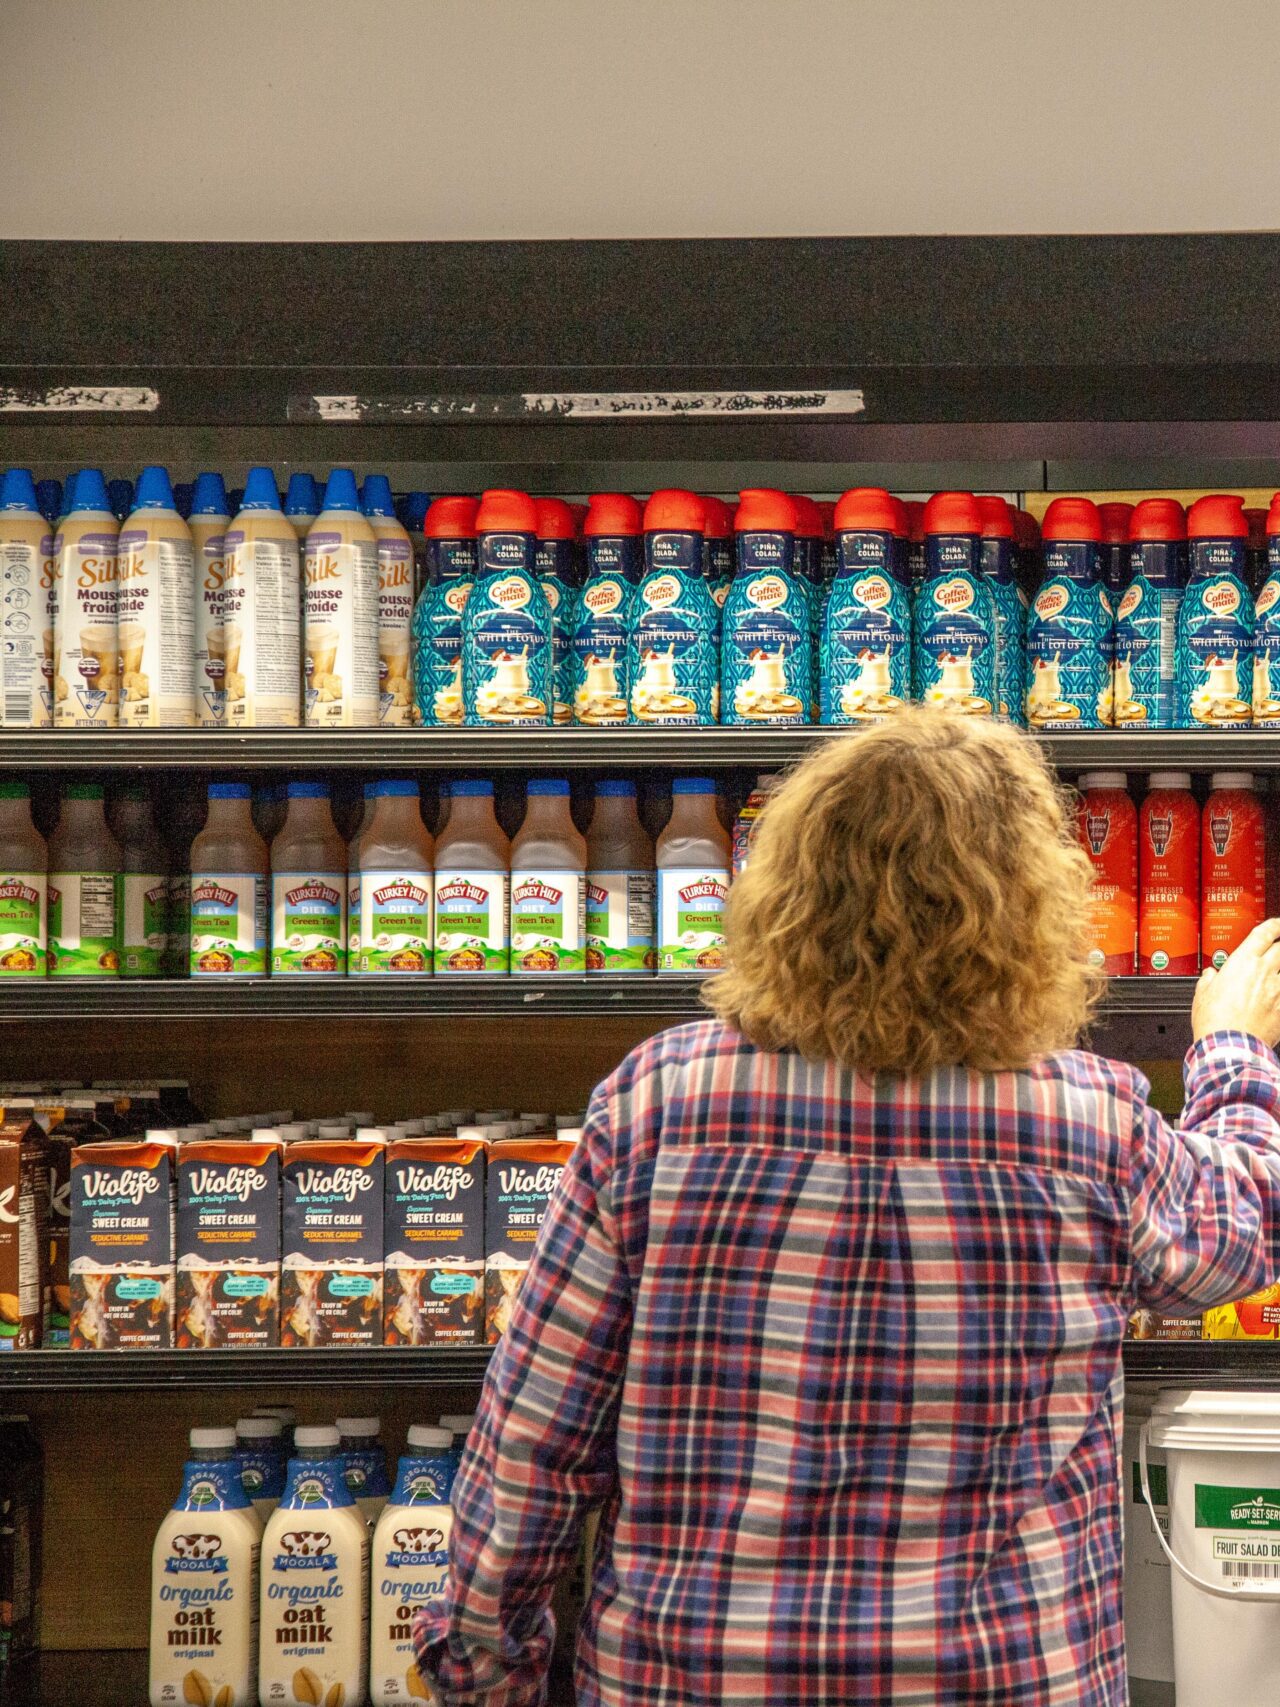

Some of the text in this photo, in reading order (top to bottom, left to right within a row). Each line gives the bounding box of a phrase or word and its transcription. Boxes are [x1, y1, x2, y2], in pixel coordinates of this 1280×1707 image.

[496, 550, 523, 558] COLADA
[754, 550, 781, 558] COLADA
[492, 586, 524, 599] Coffee
[750, 584, 781, 597] Coffee
[379, 595, 411, 605] ousse
[500, 593, 526, 603] mate
[757, 591, 782, 602] mate
[83, 602, 119, 613] froid
[478, 634, 545, 644] WHITE LOTUS
[736, 632, 800, 642] WHITE LOTUS
[288, 890, 337, 904] TURKEY HILL
[374, 887, 427, 902] TURKEY HILL
[1146, 893, 1178, 902] ENERGY
[1207, 894, 1238, 902] ENERGY
[301, 906, 326, 914] DIET
[389, 904, 414, 913] DIET
[379, 917, 423, 925] Green Tea
[82, 1170, 160, 1205] Violife
[189, 1167, 267, 1202] Violife
[296, 1168, 373, 1202] Violife
[396, 1166, 473, 1200] Violife
[92, 1218, 149, 1228] SWEET CREAM
[406, 1213, 463, 1223] SWEET CREAM
[186, 1472, 223, 1492] ORGANIC
[292, 1471, 331, 1491] ORGANIC
[1217, 1542, 1237, 1555] FRUIT
[1241, 1543, 1268, 1556] SALAD
[280, 1556, 329, 1567] MOOALA
[392, 1553, 443, 1564] MOOALA
[171, 1560, 220, 1571] MOOALA
[159, 1578, 234, 1608] Organic
[268, 1576, 343, 1606] Organic
[174, 1607, 215, 1625] oat
[283, 1605, 326, 1623] oat
[167, 1625, 222, 1645] milk
[276, 1623, 332, 1643] milk
[174, 1650, 214, 1659] original
[283, 1647, 325, 1655] original
